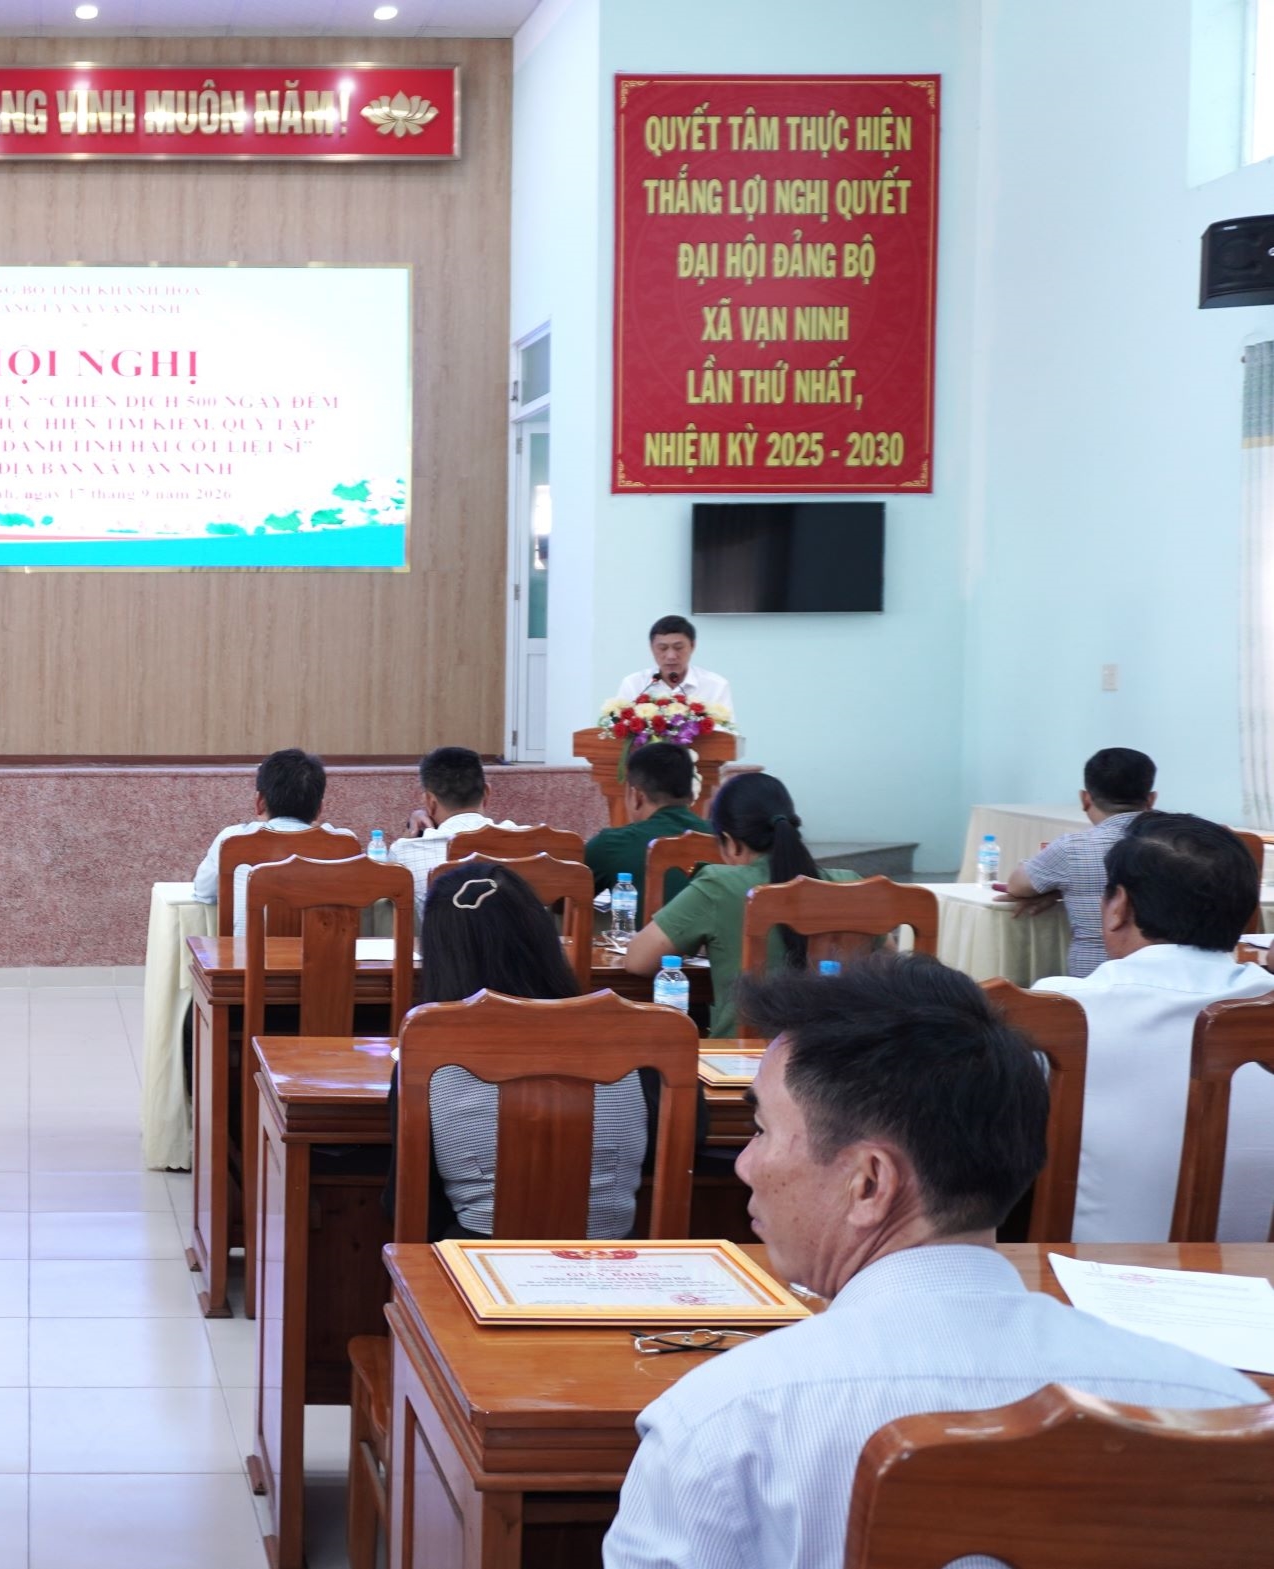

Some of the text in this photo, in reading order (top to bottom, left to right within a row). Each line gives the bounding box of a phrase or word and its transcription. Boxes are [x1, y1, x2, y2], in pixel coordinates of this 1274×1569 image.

[56, 90, 135, 135] VINH
[144, 80, 246, 135] MUÔN
[645, 102, 912, 158] QUYẾT TÂM THỰC HIỆN
[643, 164, 912, 222] THẮNG LỢI NGHỊ QUYẾT
[678, 229, 875, 285] ĐẠI HỘI ĐẢNG BỘ
[702, 297, 849, 348] XÃ VẠN NINH
[77, 348, 200, 385] NGHỊ
[687, 354, 863, 411] LẦN THỨ NHẤT,
[187, 396, 217, 407] 500
[644, 422, 719, 473] NHIỆM
[728, 423, 759, 467] KỲ
[766, 432, 824, 466] 2025
[846, 432, 904, 466] 2030
